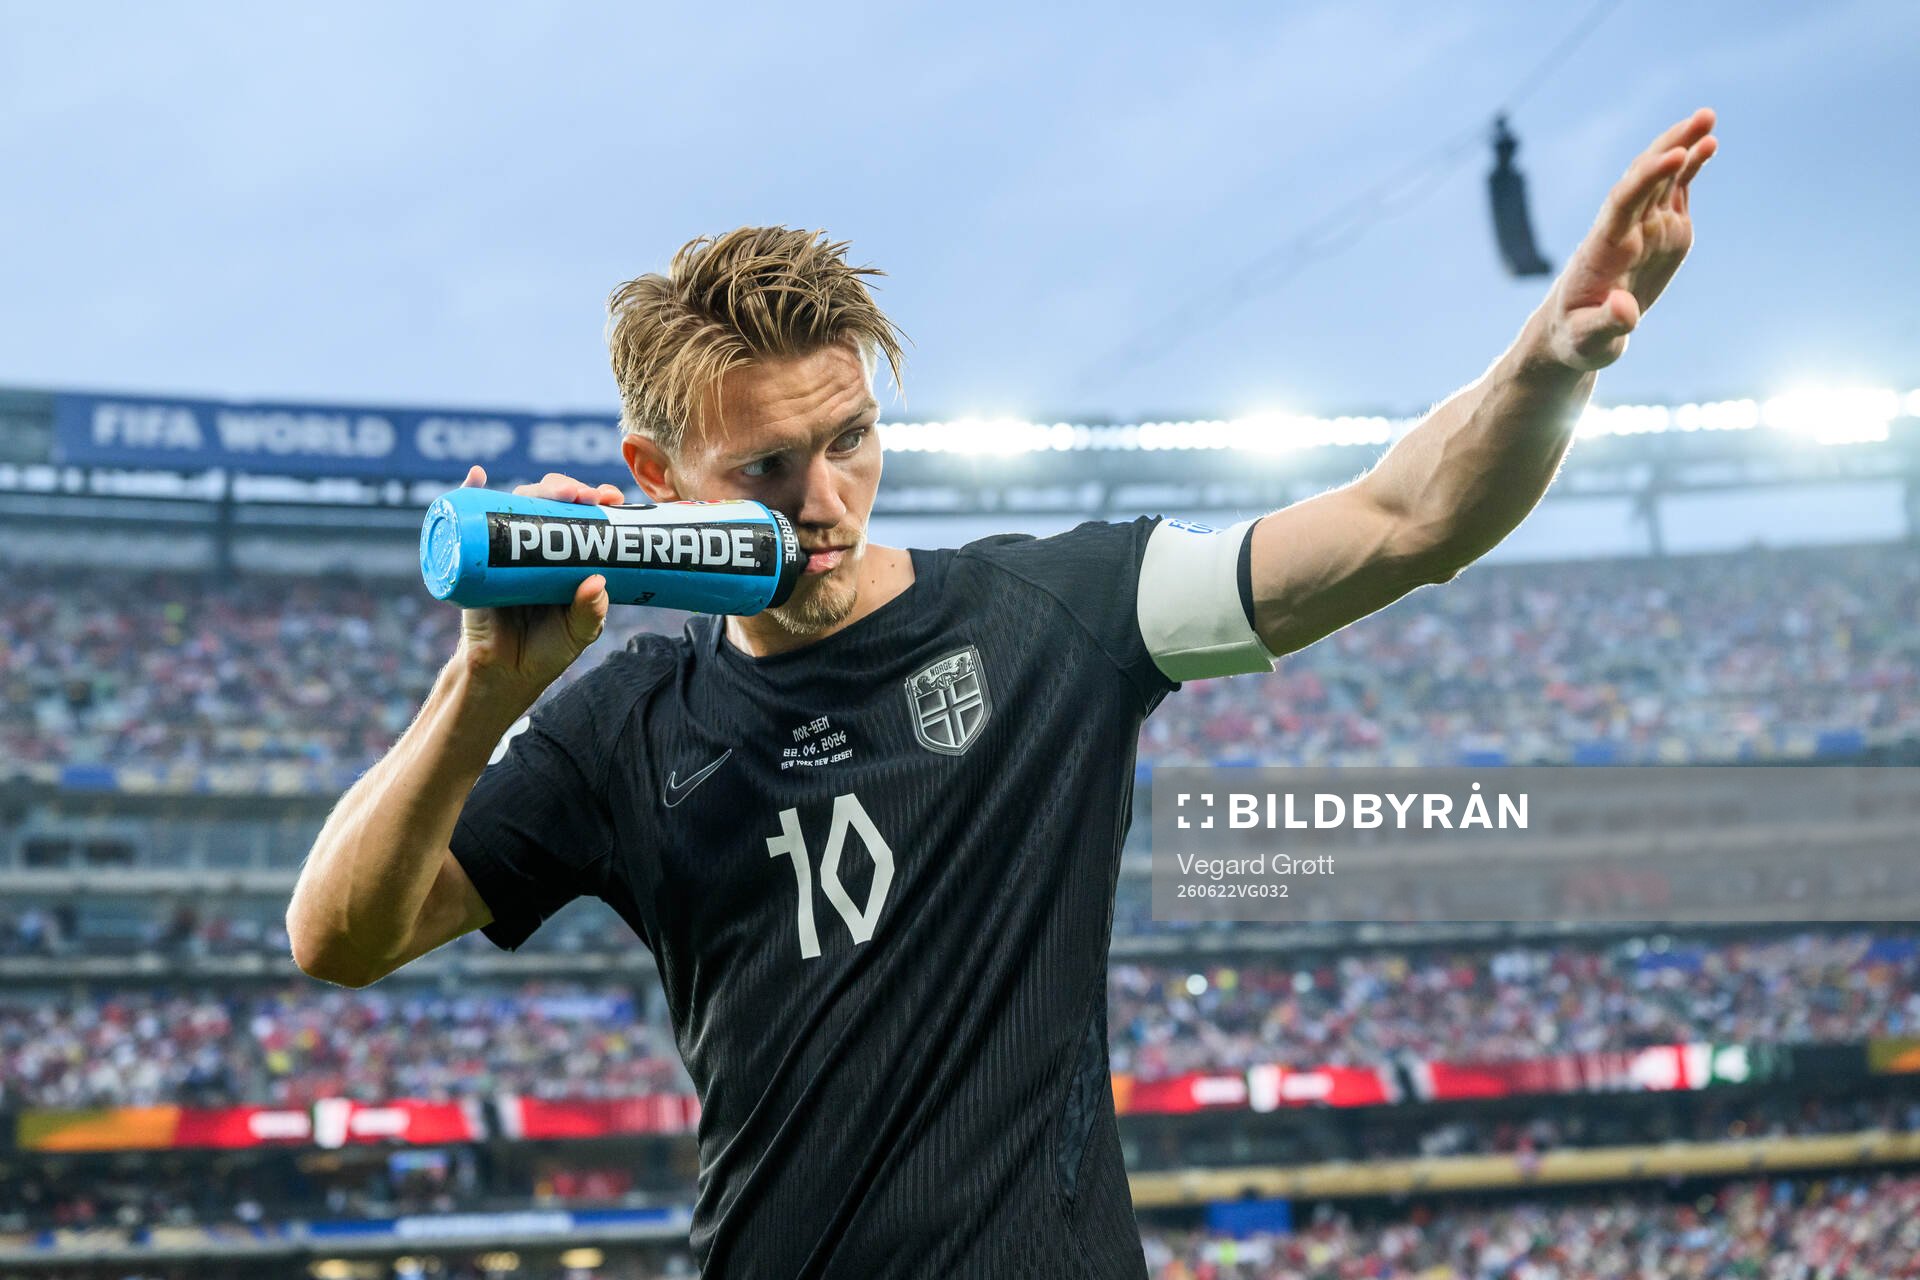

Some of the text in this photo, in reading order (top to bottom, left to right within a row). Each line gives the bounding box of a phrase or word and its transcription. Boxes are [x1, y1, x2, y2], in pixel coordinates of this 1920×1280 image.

[91, 403, 204, 450] FIFA
[216, 410, 397, 459] WORLD
[415, 417, 516, 461] CUP
[510, 520, 758, 567] POWERADE
[930, 659, 953, 678] NORGE
[781, 748, 853, 771] NEW YORK NEW JERSEY
[766, 793, 895, 959] 10
